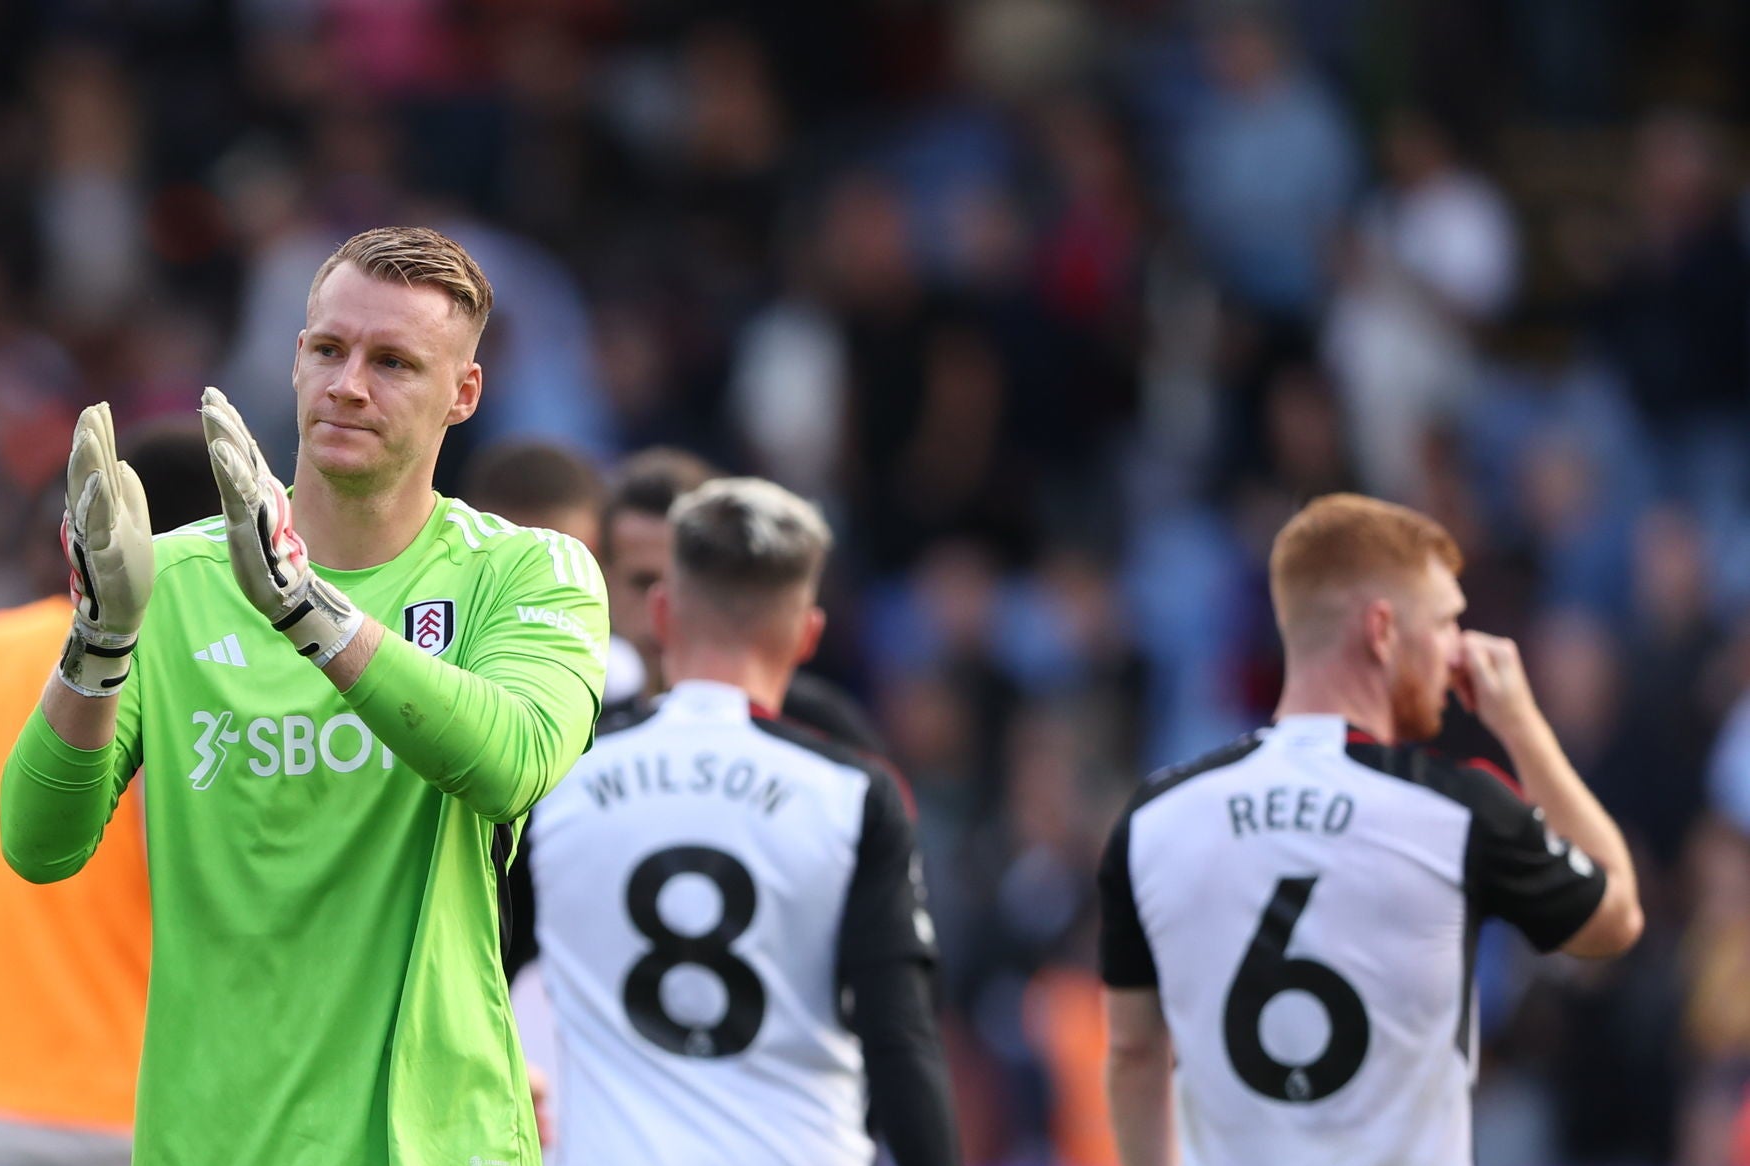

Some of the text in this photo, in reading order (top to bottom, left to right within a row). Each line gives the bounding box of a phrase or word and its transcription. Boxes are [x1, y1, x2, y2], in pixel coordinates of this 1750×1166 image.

[416, 608, 442, 649] FFC
[587, 752, 792, 815] WILSON
[1227, 786, 1354, 839] REED
[622, 844, 766, 1059] 8
[1224, 874, 1370, 1103] 6
